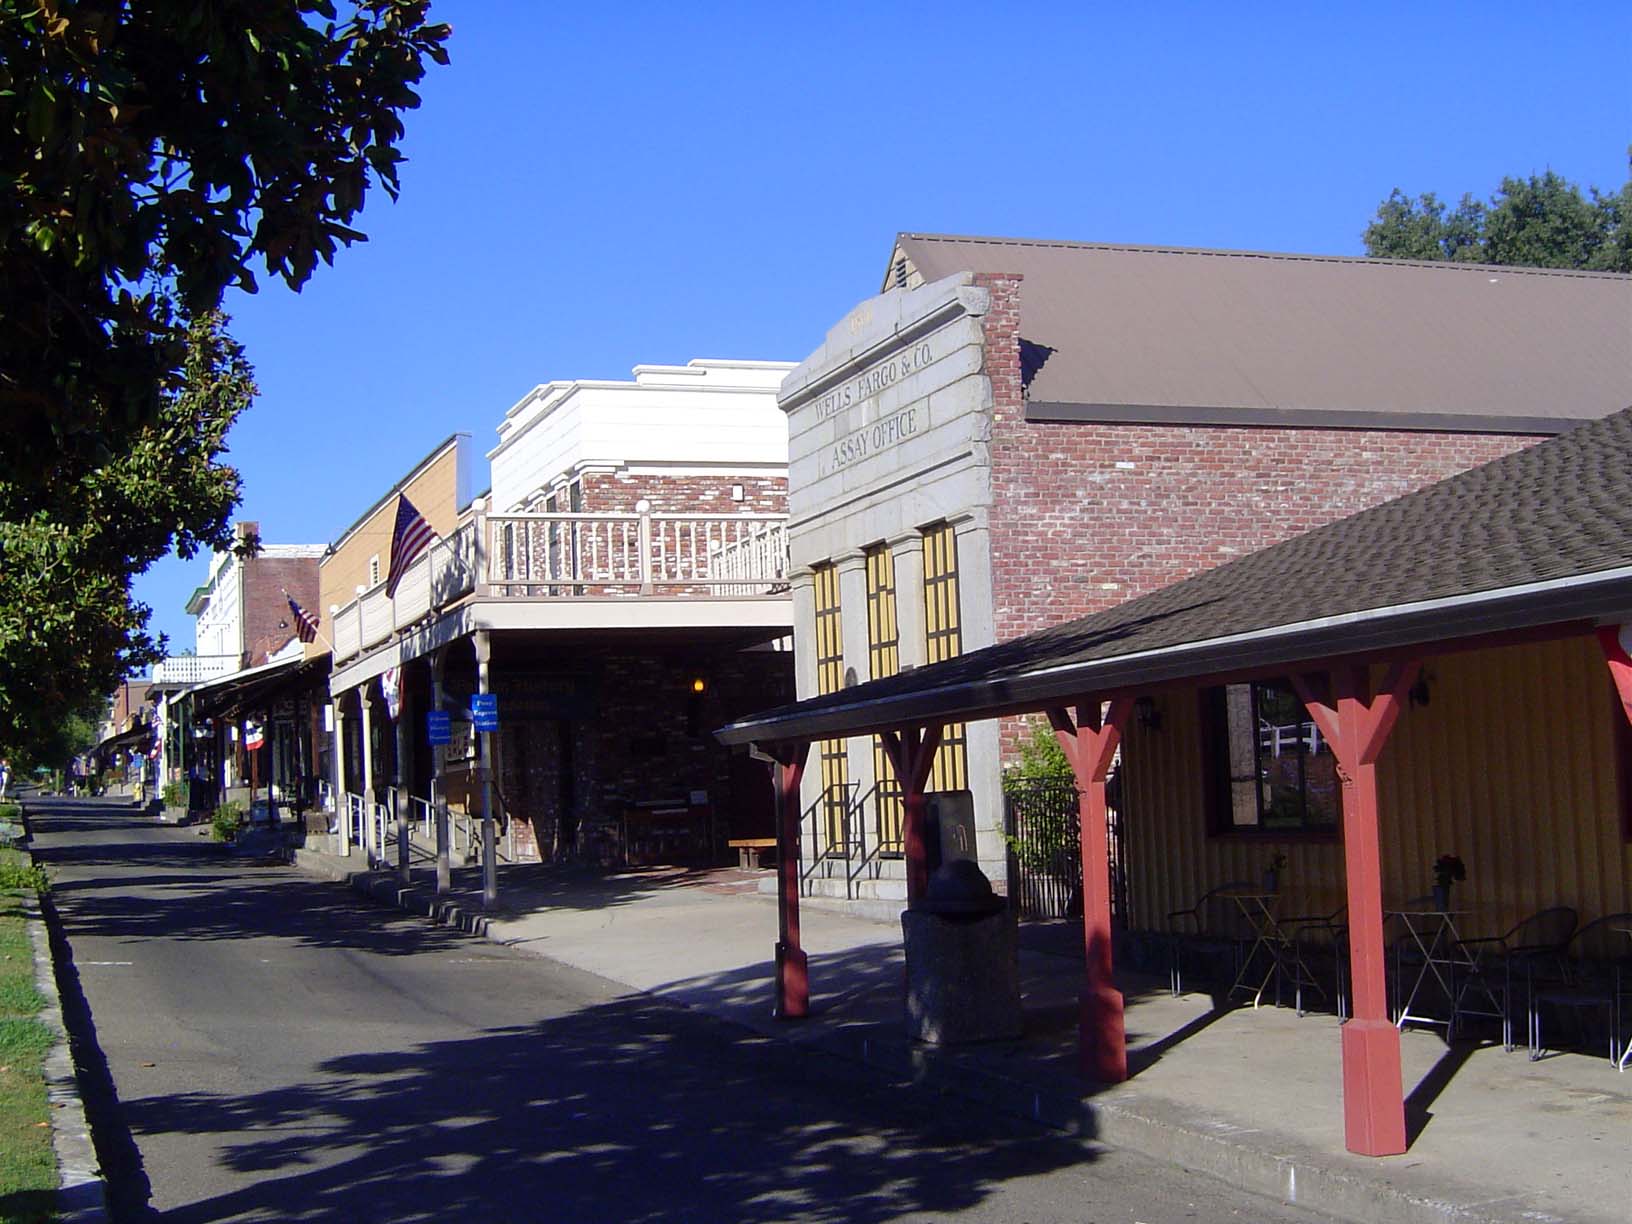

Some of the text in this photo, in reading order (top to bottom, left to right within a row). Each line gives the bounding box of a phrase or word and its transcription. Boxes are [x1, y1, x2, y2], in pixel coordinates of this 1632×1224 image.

[815, 343, 933, 420] WELLS FARGO & CO.
[831, 408, 917, 470] ASSAY OFFICE
